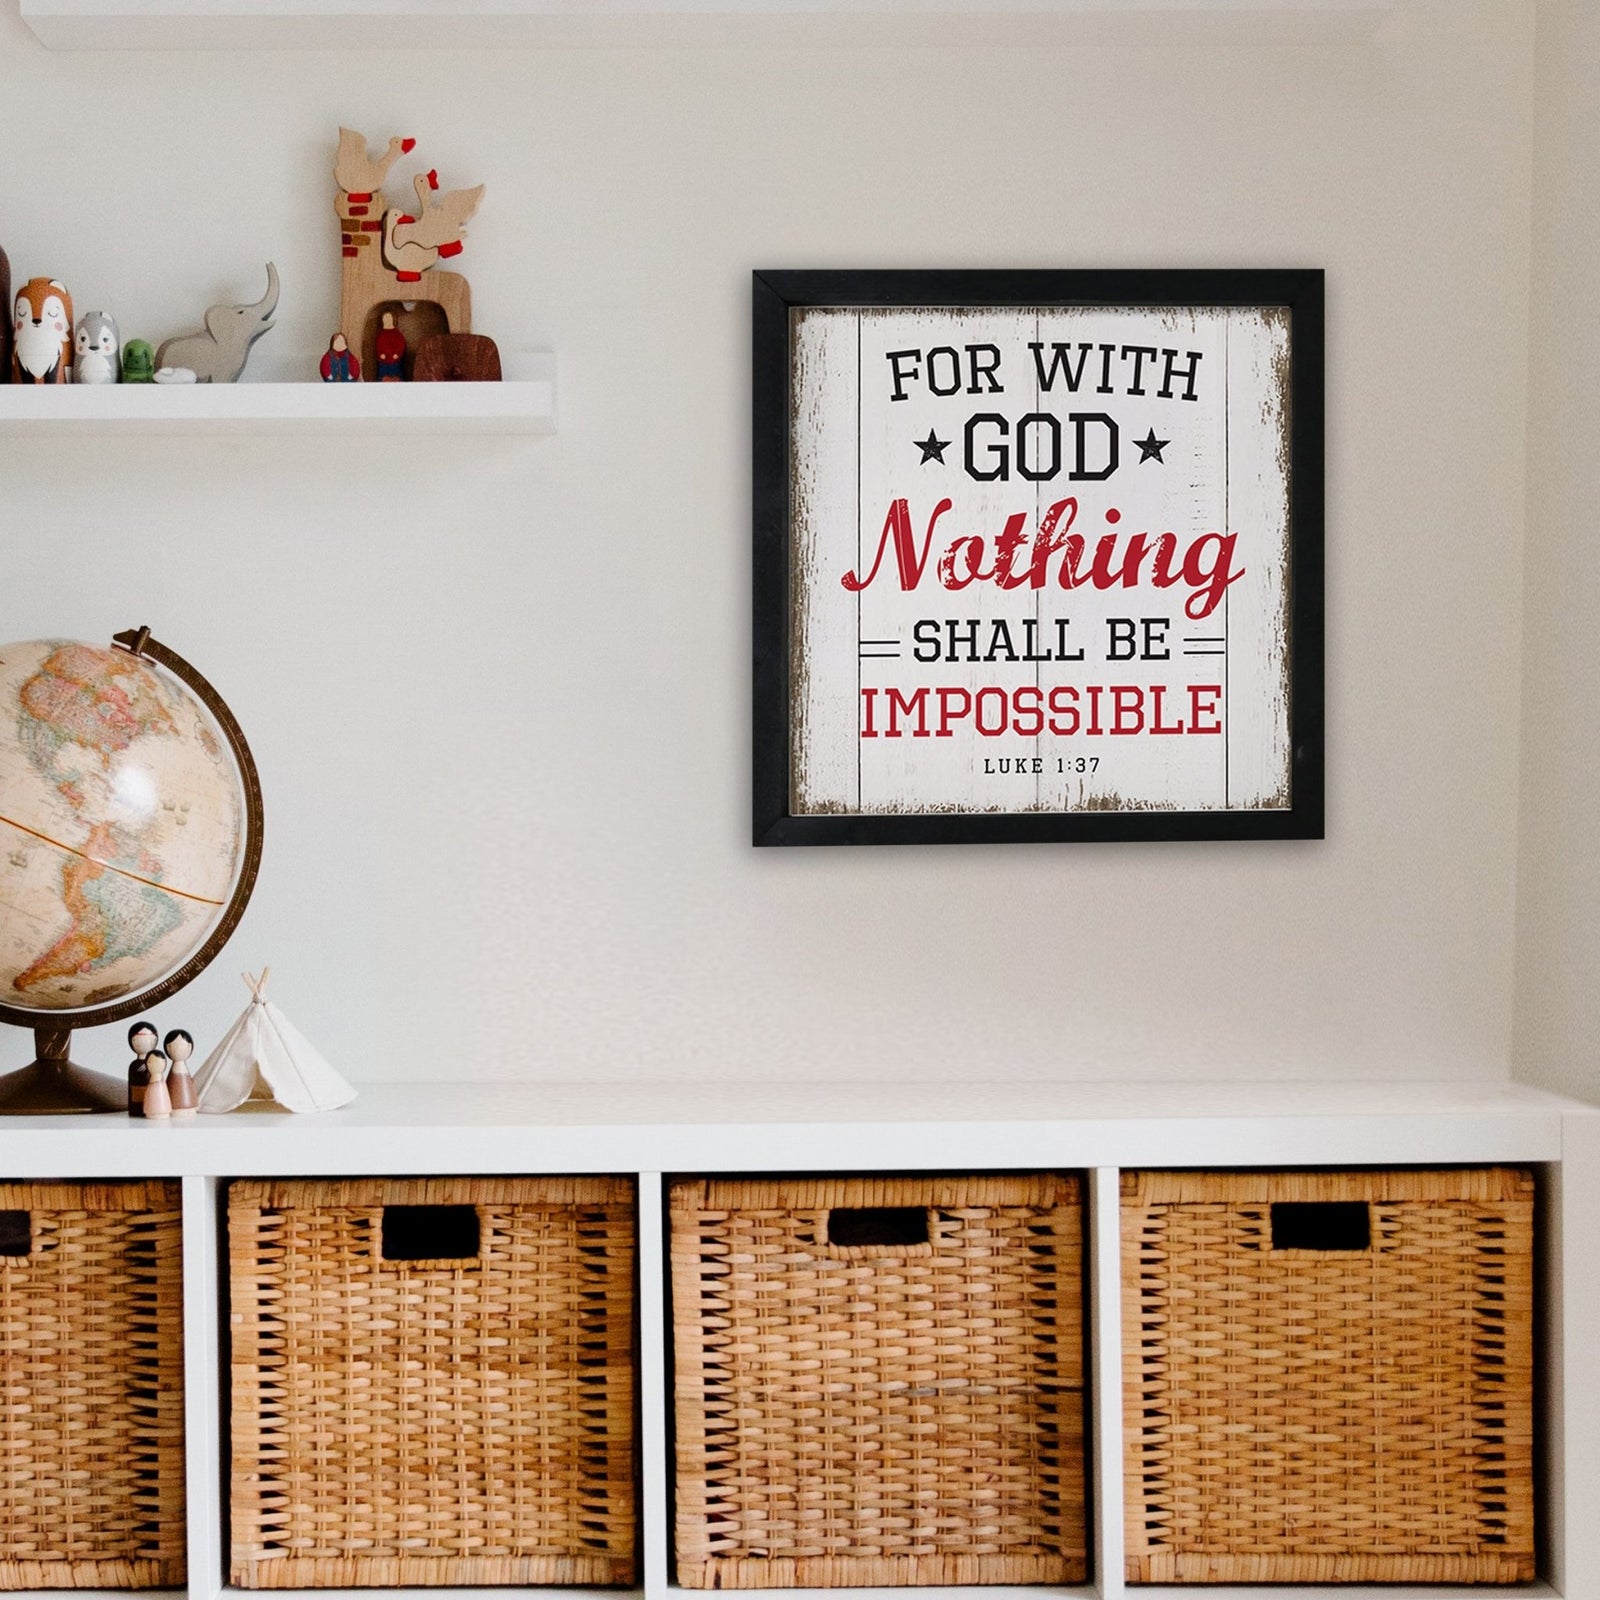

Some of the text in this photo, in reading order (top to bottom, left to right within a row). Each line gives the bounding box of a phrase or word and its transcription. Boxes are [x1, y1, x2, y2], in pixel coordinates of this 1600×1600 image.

[886, 342, 1203, 402] FOR WITH
[963, 412, 1119, 481] GOD
[841, 496, 1246, 620] Nothing
[912, 618, 1170, 663] SHALL BE
[860, 685, 1222, 738] IMPOSSIBLE
[984, 757, 1100, 774] LUKE 1:37
